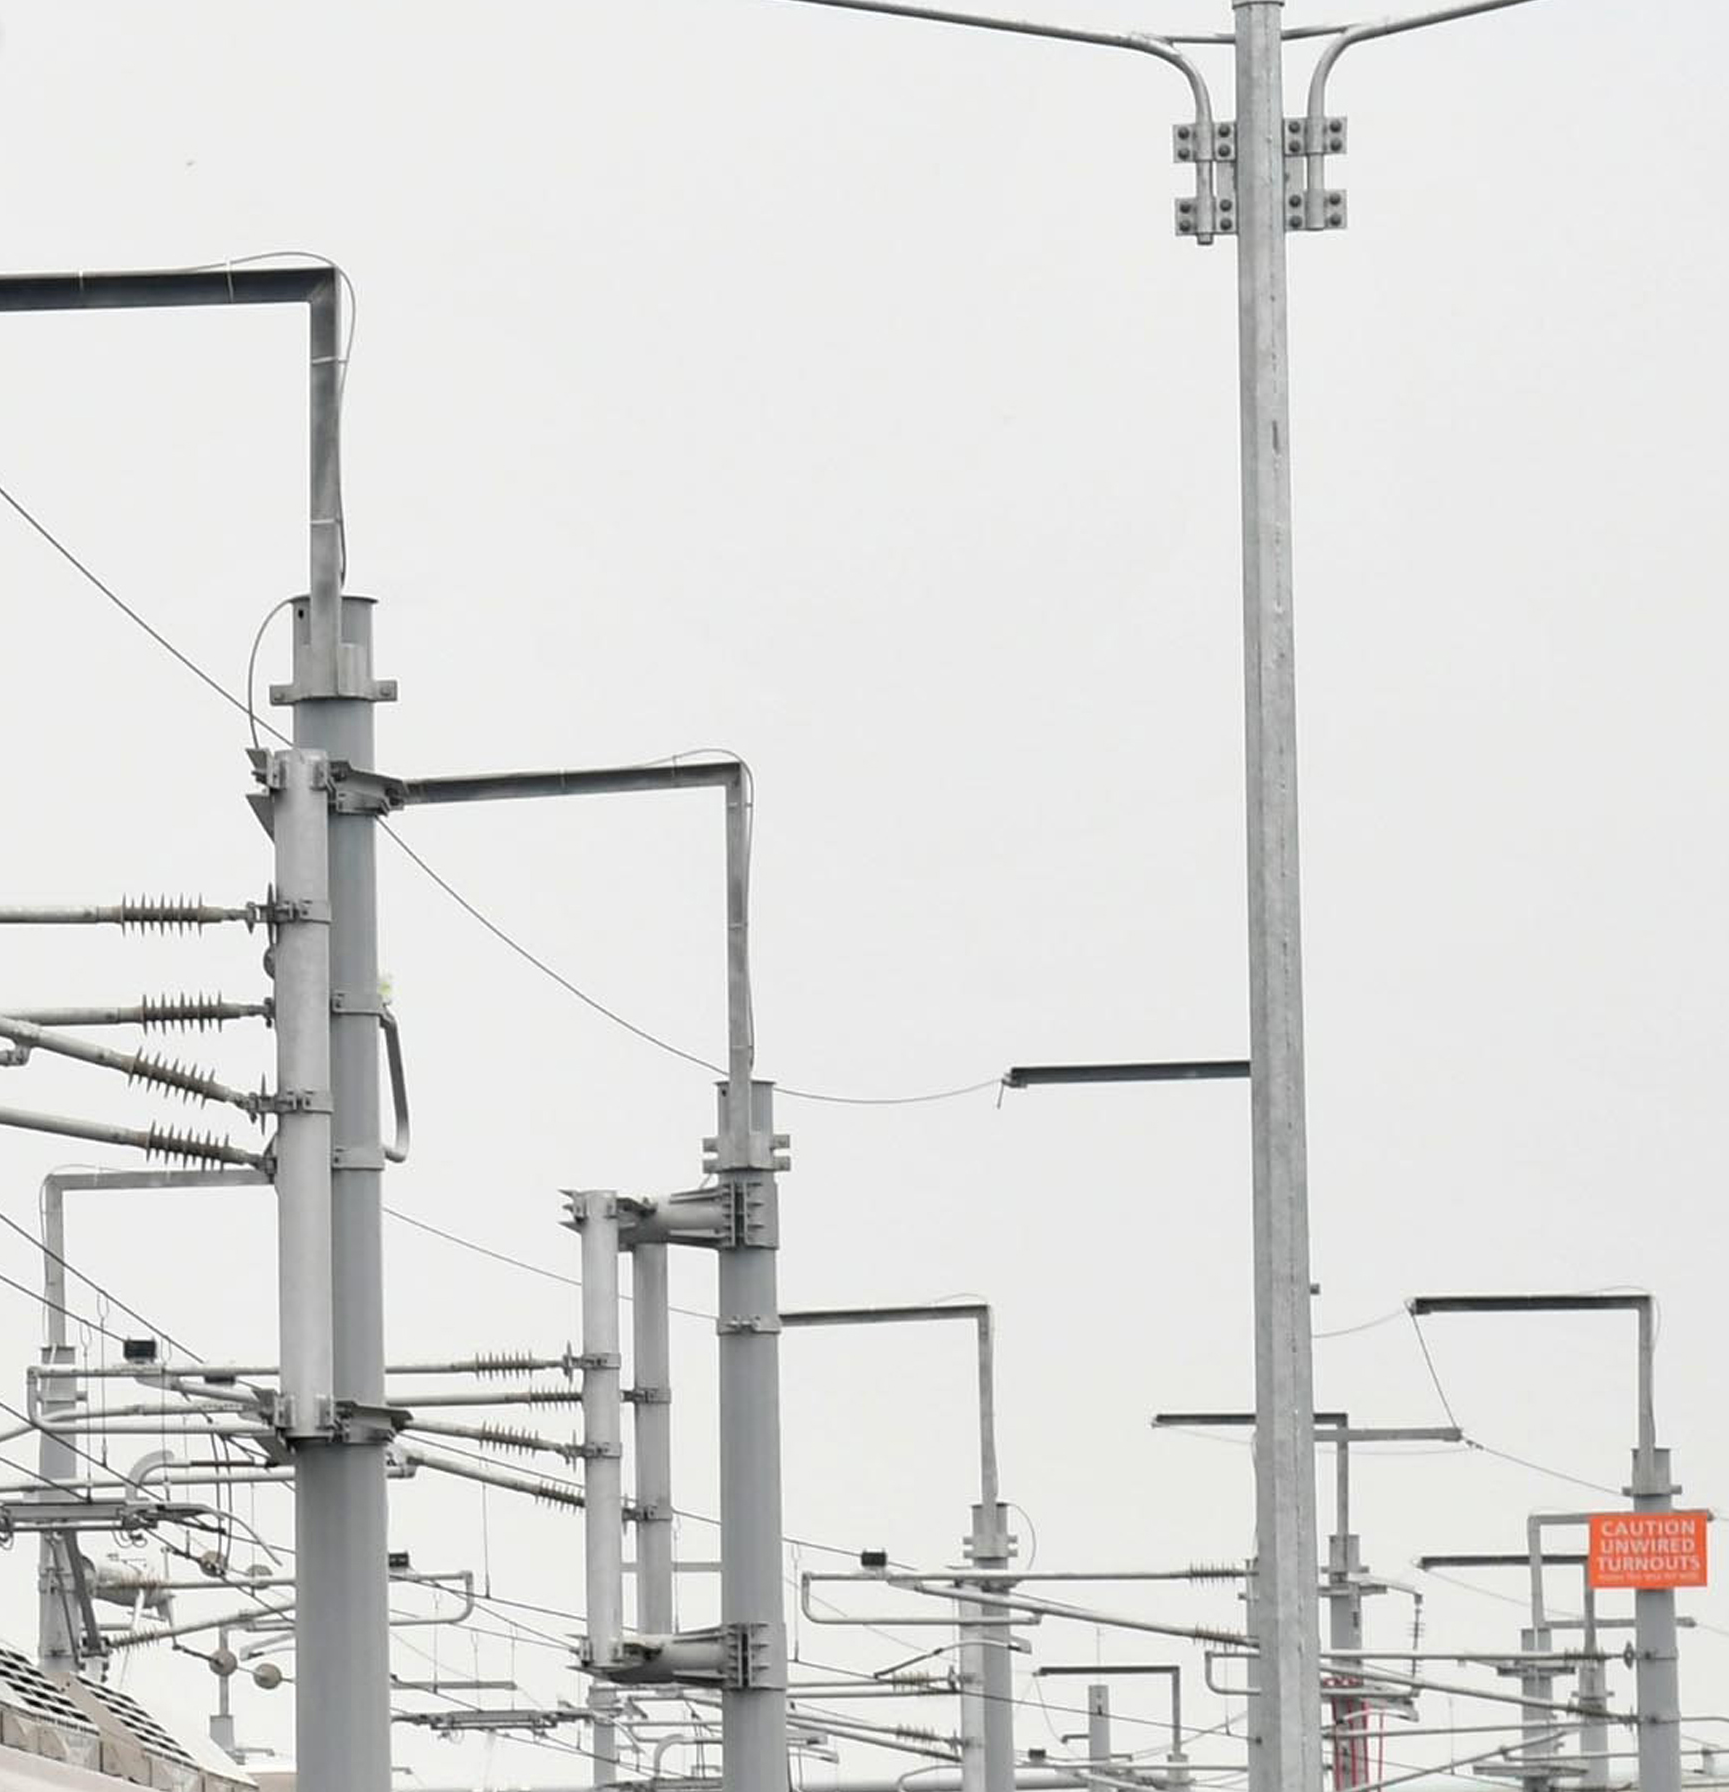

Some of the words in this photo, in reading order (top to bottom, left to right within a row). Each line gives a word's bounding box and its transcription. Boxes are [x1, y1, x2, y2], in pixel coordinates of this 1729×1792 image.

[1601, 1519, 1695, 1537] CAUTION
[1600, 1537, 1695, 1554] UNWIRED
[1596, 1555, 1701, 1572] TURNOUTS
